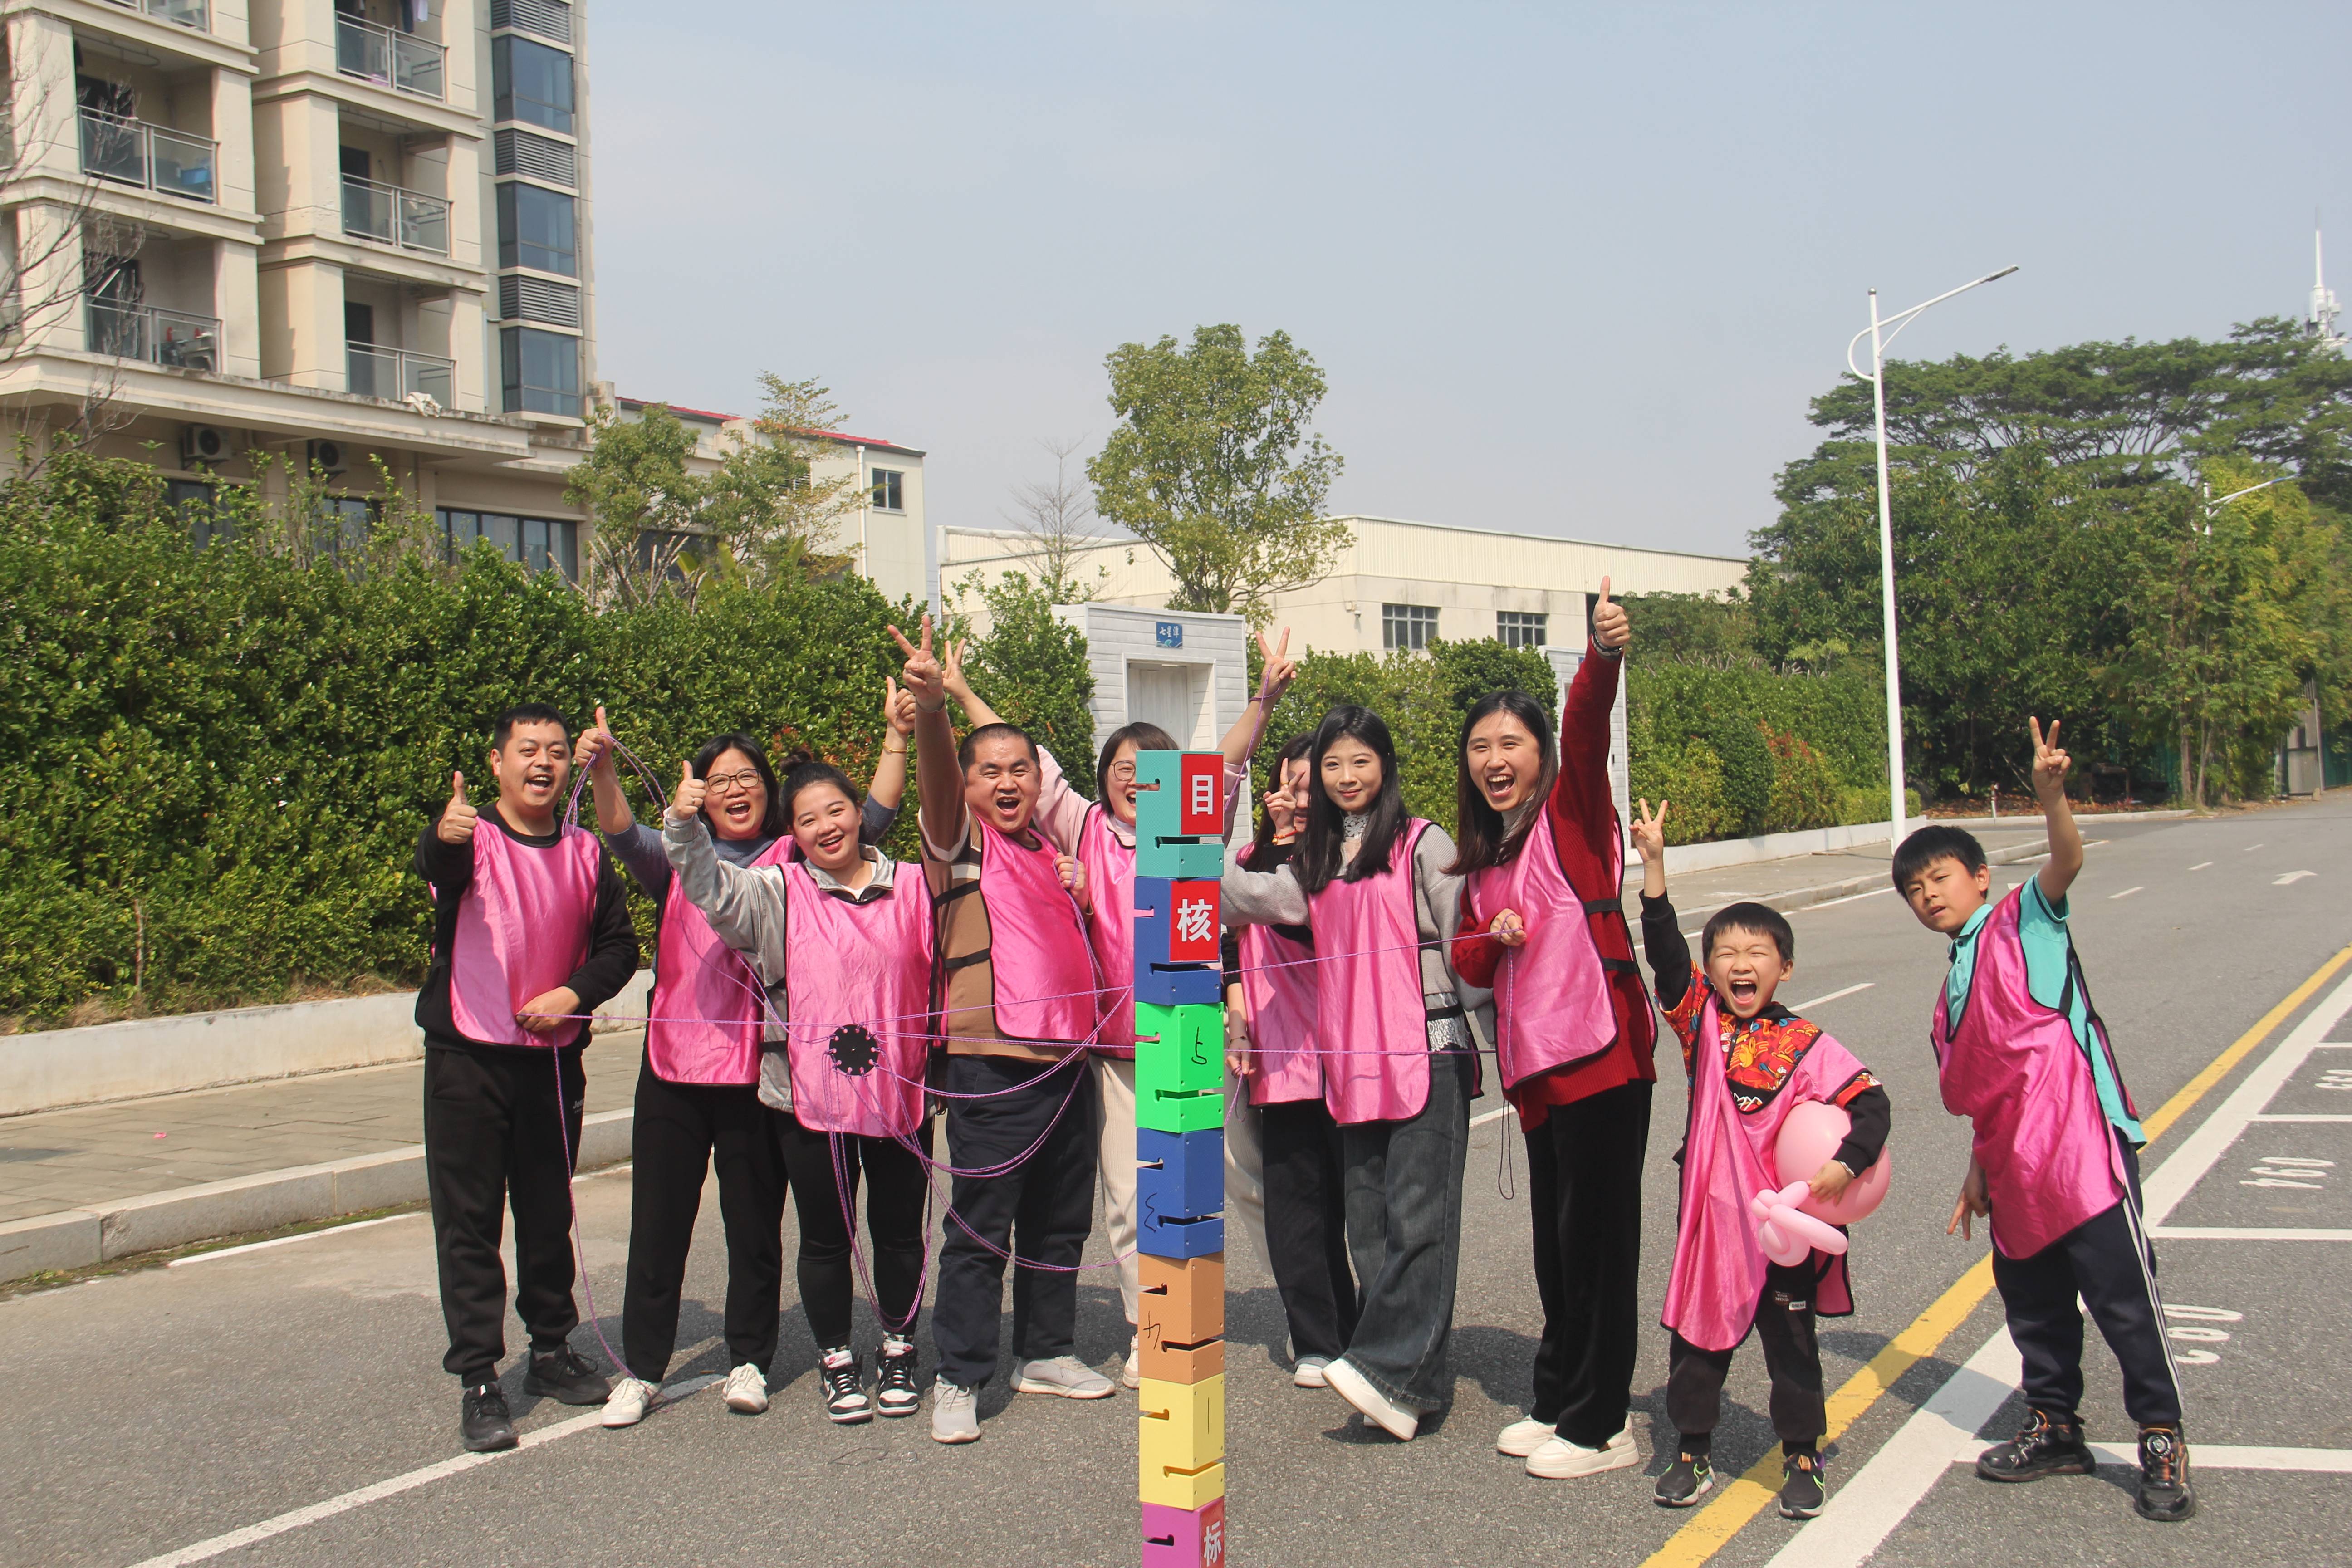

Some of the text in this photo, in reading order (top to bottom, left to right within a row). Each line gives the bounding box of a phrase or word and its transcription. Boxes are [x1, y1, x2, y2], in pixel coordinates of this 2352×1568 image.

[1192, 775, 1213, 815] 目
[1176, 899, 1213, 942] 核
[1204, 1521, 1221, 1567] 标
